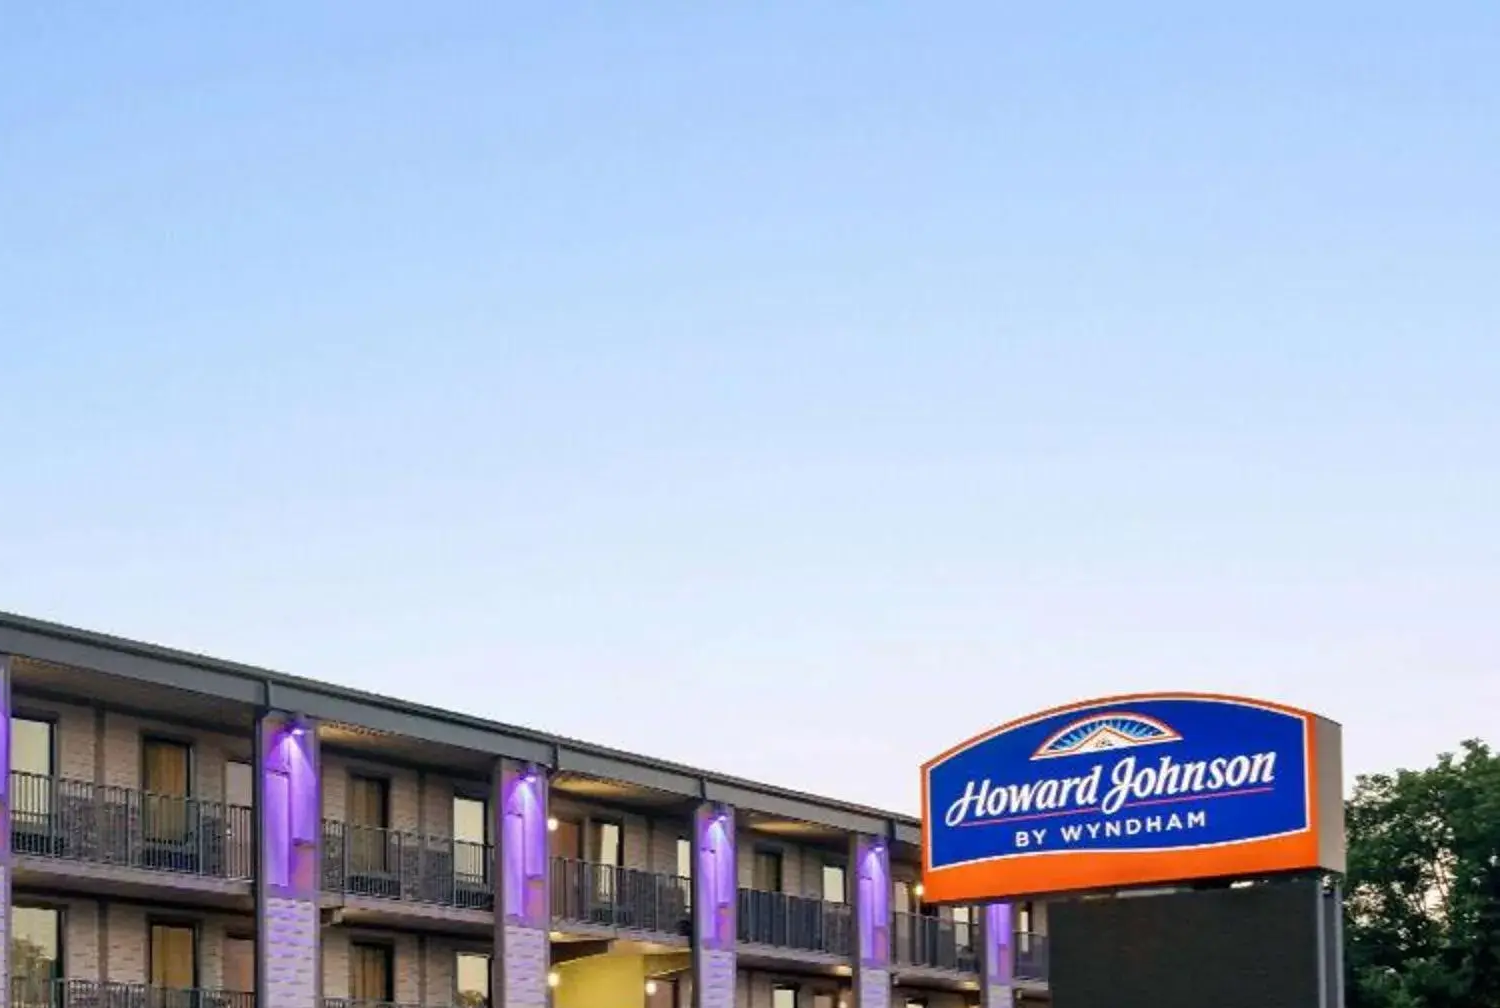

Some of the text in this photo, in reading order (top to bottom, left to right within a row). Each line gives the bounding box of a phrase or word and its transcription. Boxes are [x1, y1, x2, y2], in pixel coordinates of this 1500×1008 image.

[946, 751, 1276, 827] Howard Johnson
[1015, 811, 1207, 848] BY WYNDHAM
